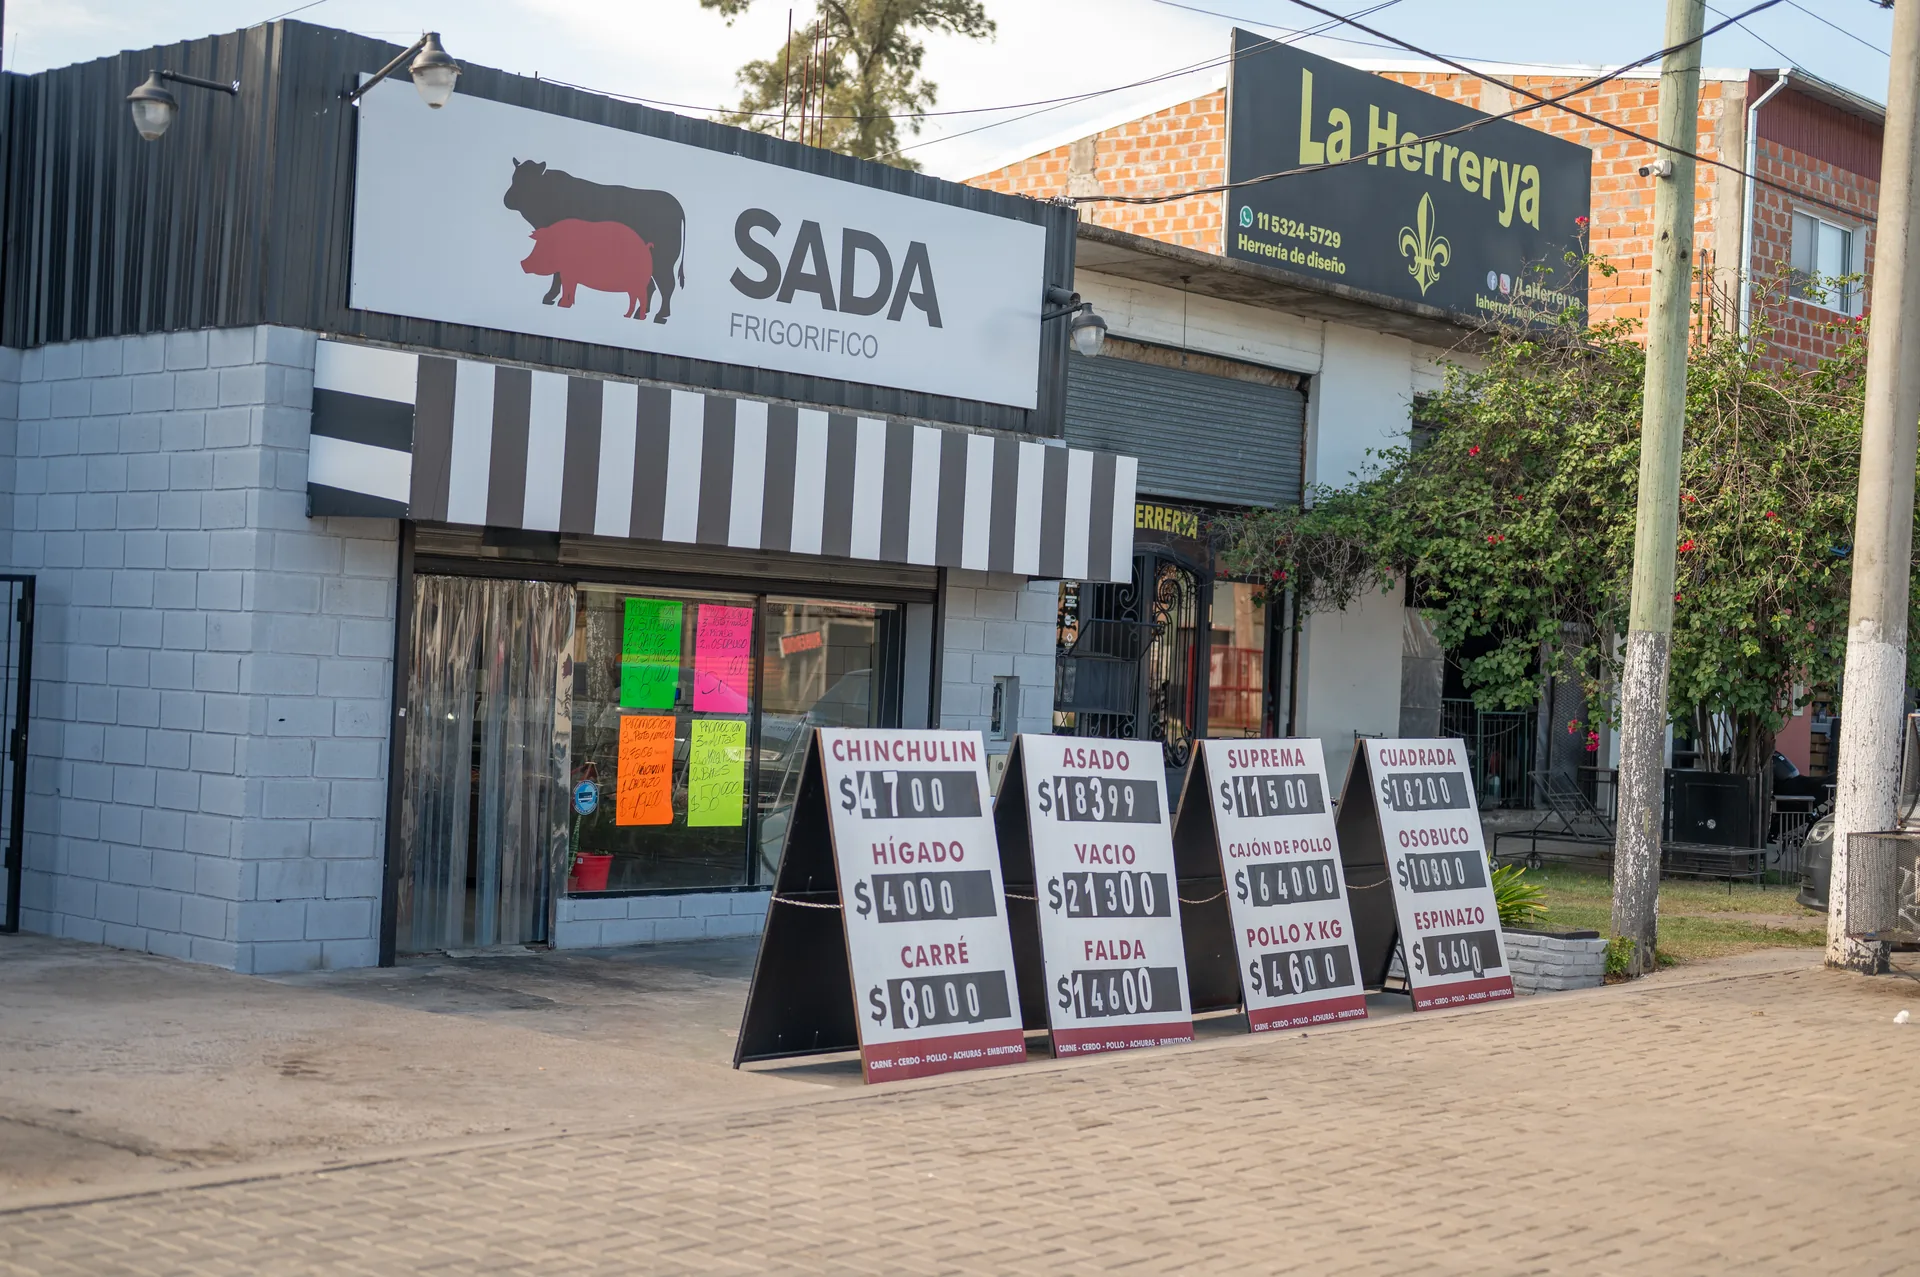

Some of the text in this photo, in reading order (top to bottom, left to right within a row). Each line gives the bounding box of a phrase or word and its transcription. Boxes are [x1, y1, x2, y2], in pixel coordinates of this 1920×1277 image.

[1299, 67, 1540, 231] La Herrerya
[1238, 233, 1346, 275] Herrería de diseño
[730, 208, 943, 328] SADA
[730, 312, 878, 359] FRIGORIFICO
[832, 740, 976, 762] CHINCHULIN
[1062, 748, 1130, 771] ASADO
[1228, 748, 1305, 768] SUPREMA
[1379, 748, 1456, 766] CUADRADA
[1229, 837, 1332, 858] CAJÓN DE POLLO
[1399, 827, 1469, 848] OSOBUCO
[872, 836, 964, 865] HÍGADO
[1074, 844, 1136, 865] VACIO
[1414, 907, 1485, 930] ESPINAZO
[1247, 919, 1342, 947] POLLO X KG
[901, 936, 969, 968] CARRÉ
[1084, 940, 1147, 961] FALDA
[1255, 1023, 1268, 1031] CARNE
[1293, 1016, 1308, 1025] POLLO
[1313, 1013, 1334, 1022] ACHURAS
[1338, 1008, 1364, 1018] EMBUTIDOS
[1106, 1041, 1124, 1049] POLLO
[1130, 1039, 1155, 1047] ACHURAS
[871, 1060, 892, 1069] CARNE
[898, 1056, 920, 1066] CERDO
[926, 1053, 947, 1063] POLLO
[953, 1049, 981, 1060] ACHURAS
[987, 1045, 1022, 1056] EMBUTIDOS
